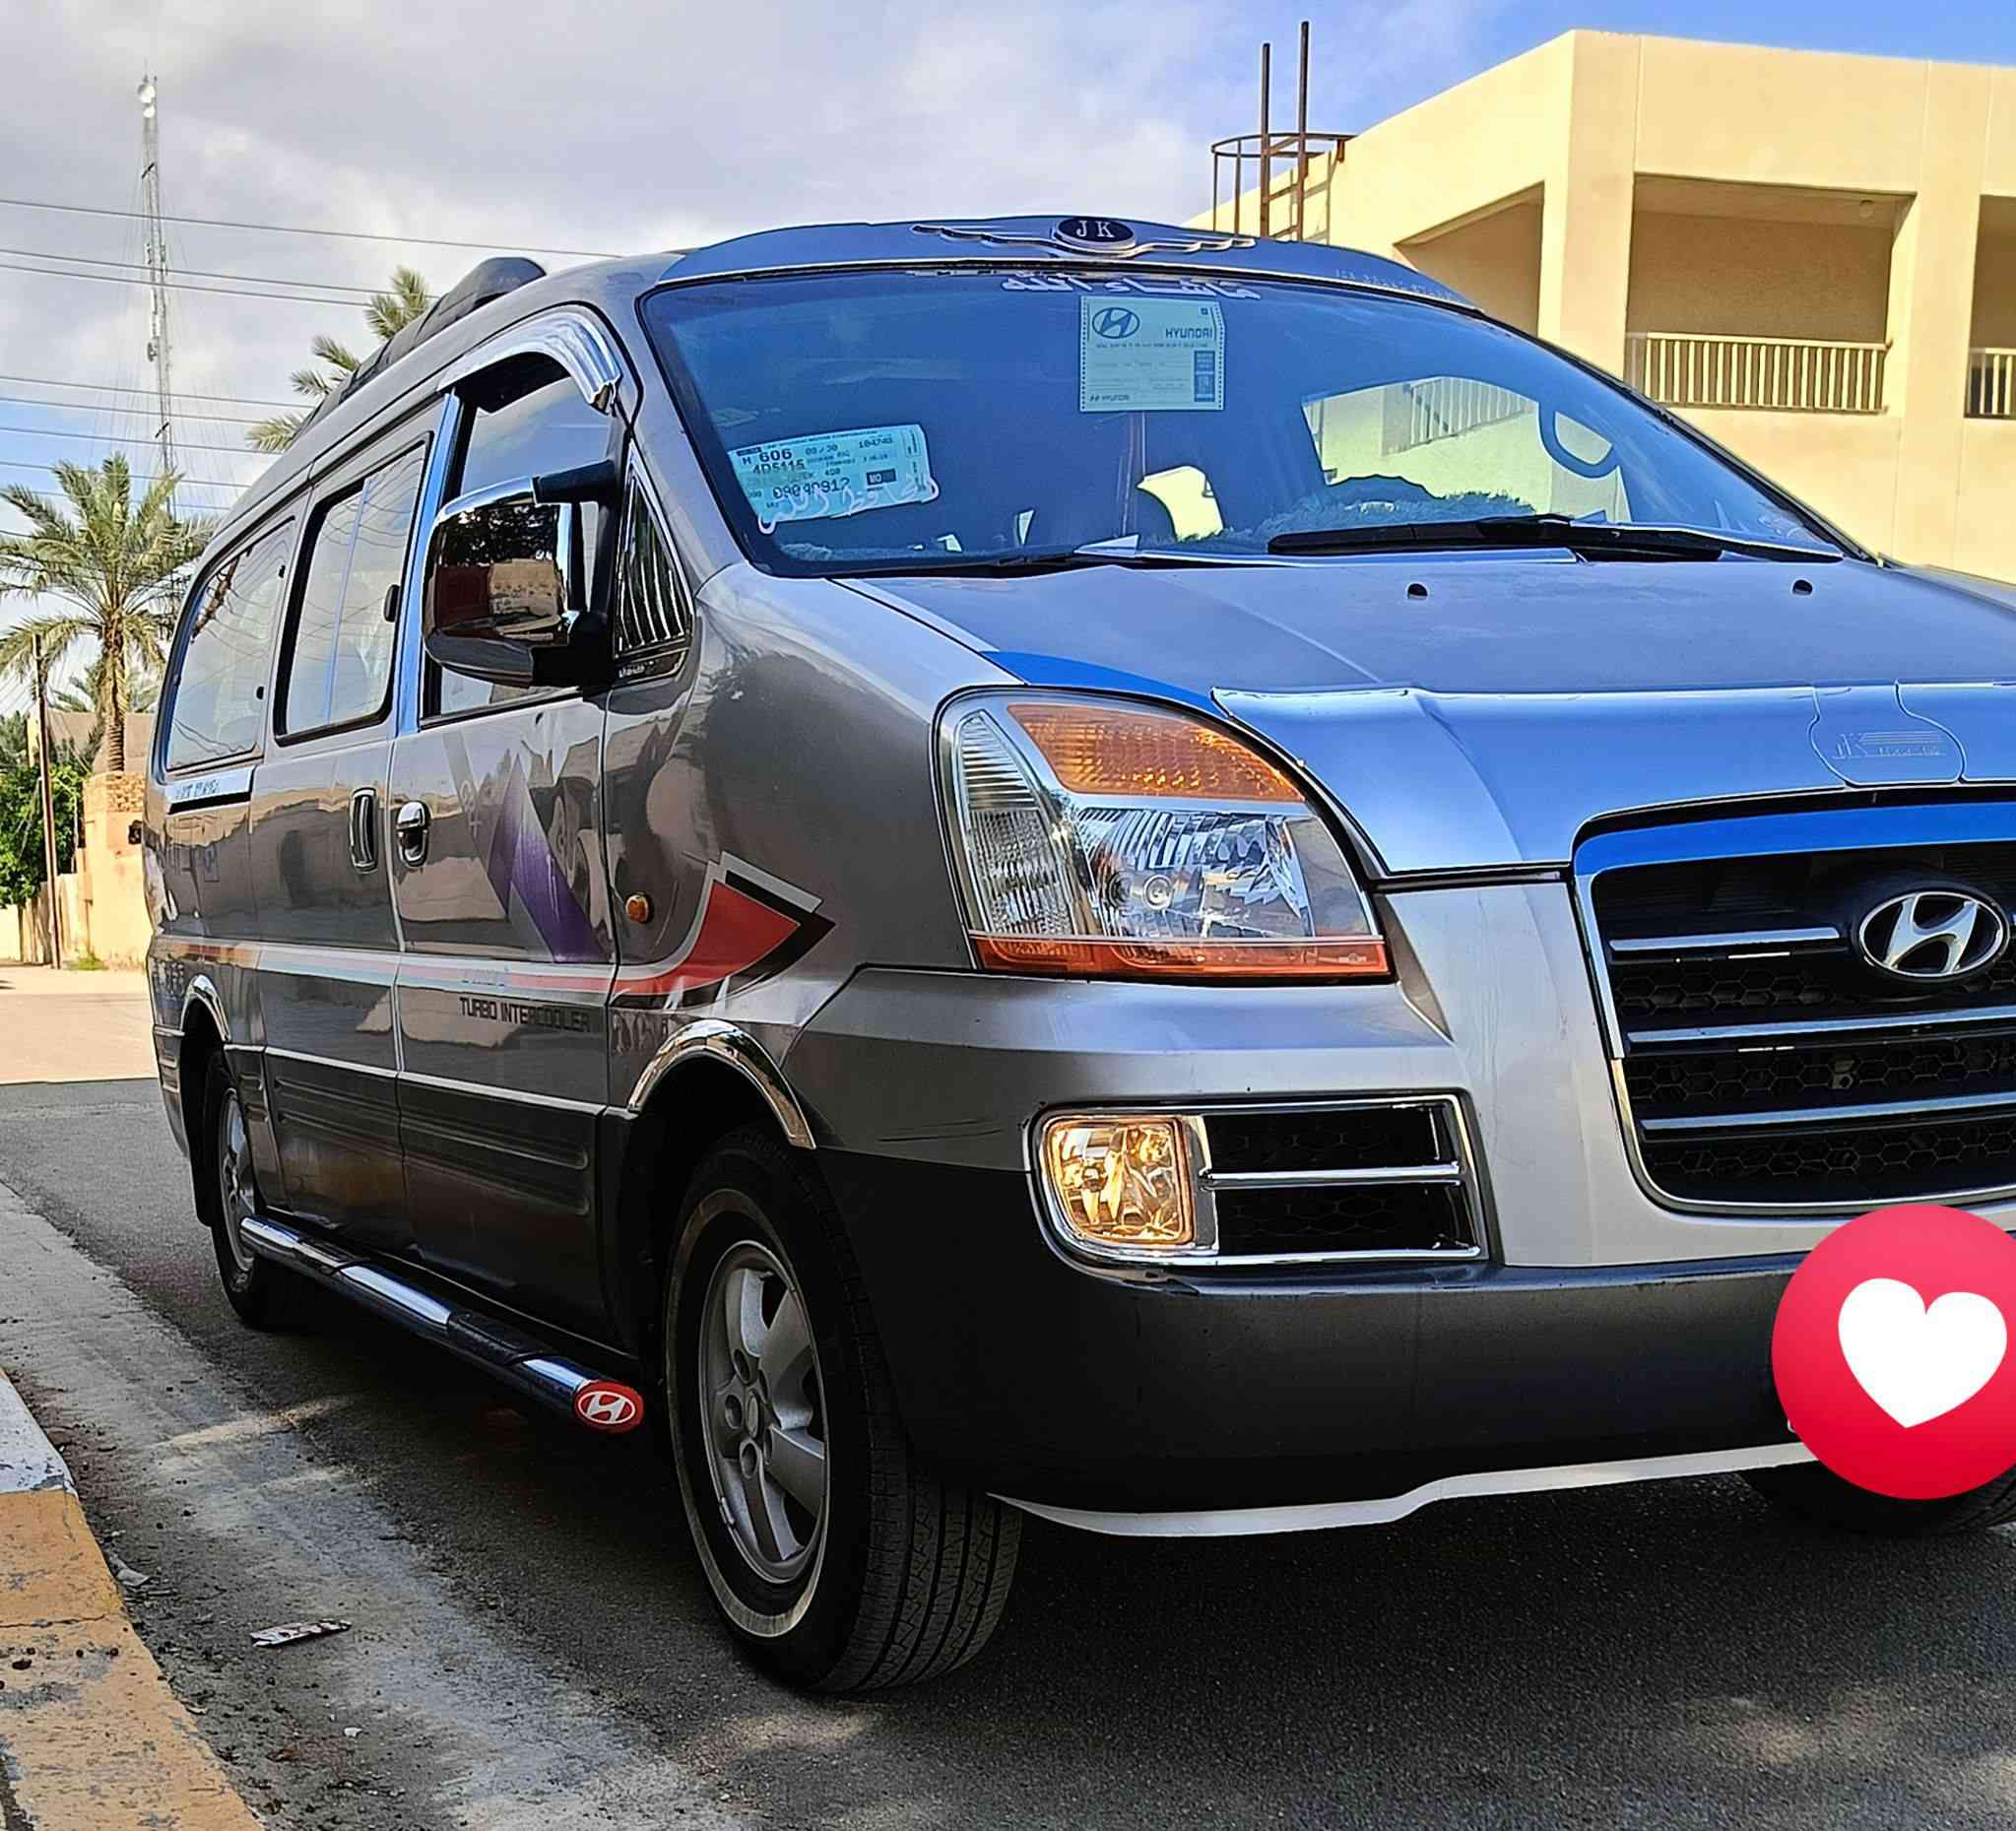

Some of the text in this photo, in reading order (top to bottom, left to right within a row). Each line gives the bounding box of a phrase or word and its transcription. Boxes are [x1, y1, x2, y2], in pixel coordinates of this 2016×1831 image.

[1165, 327, 1212, 339] HYUNDAI
[759, 448, 793, 463] 606
[459, 997, 498, 1020] TURBO
